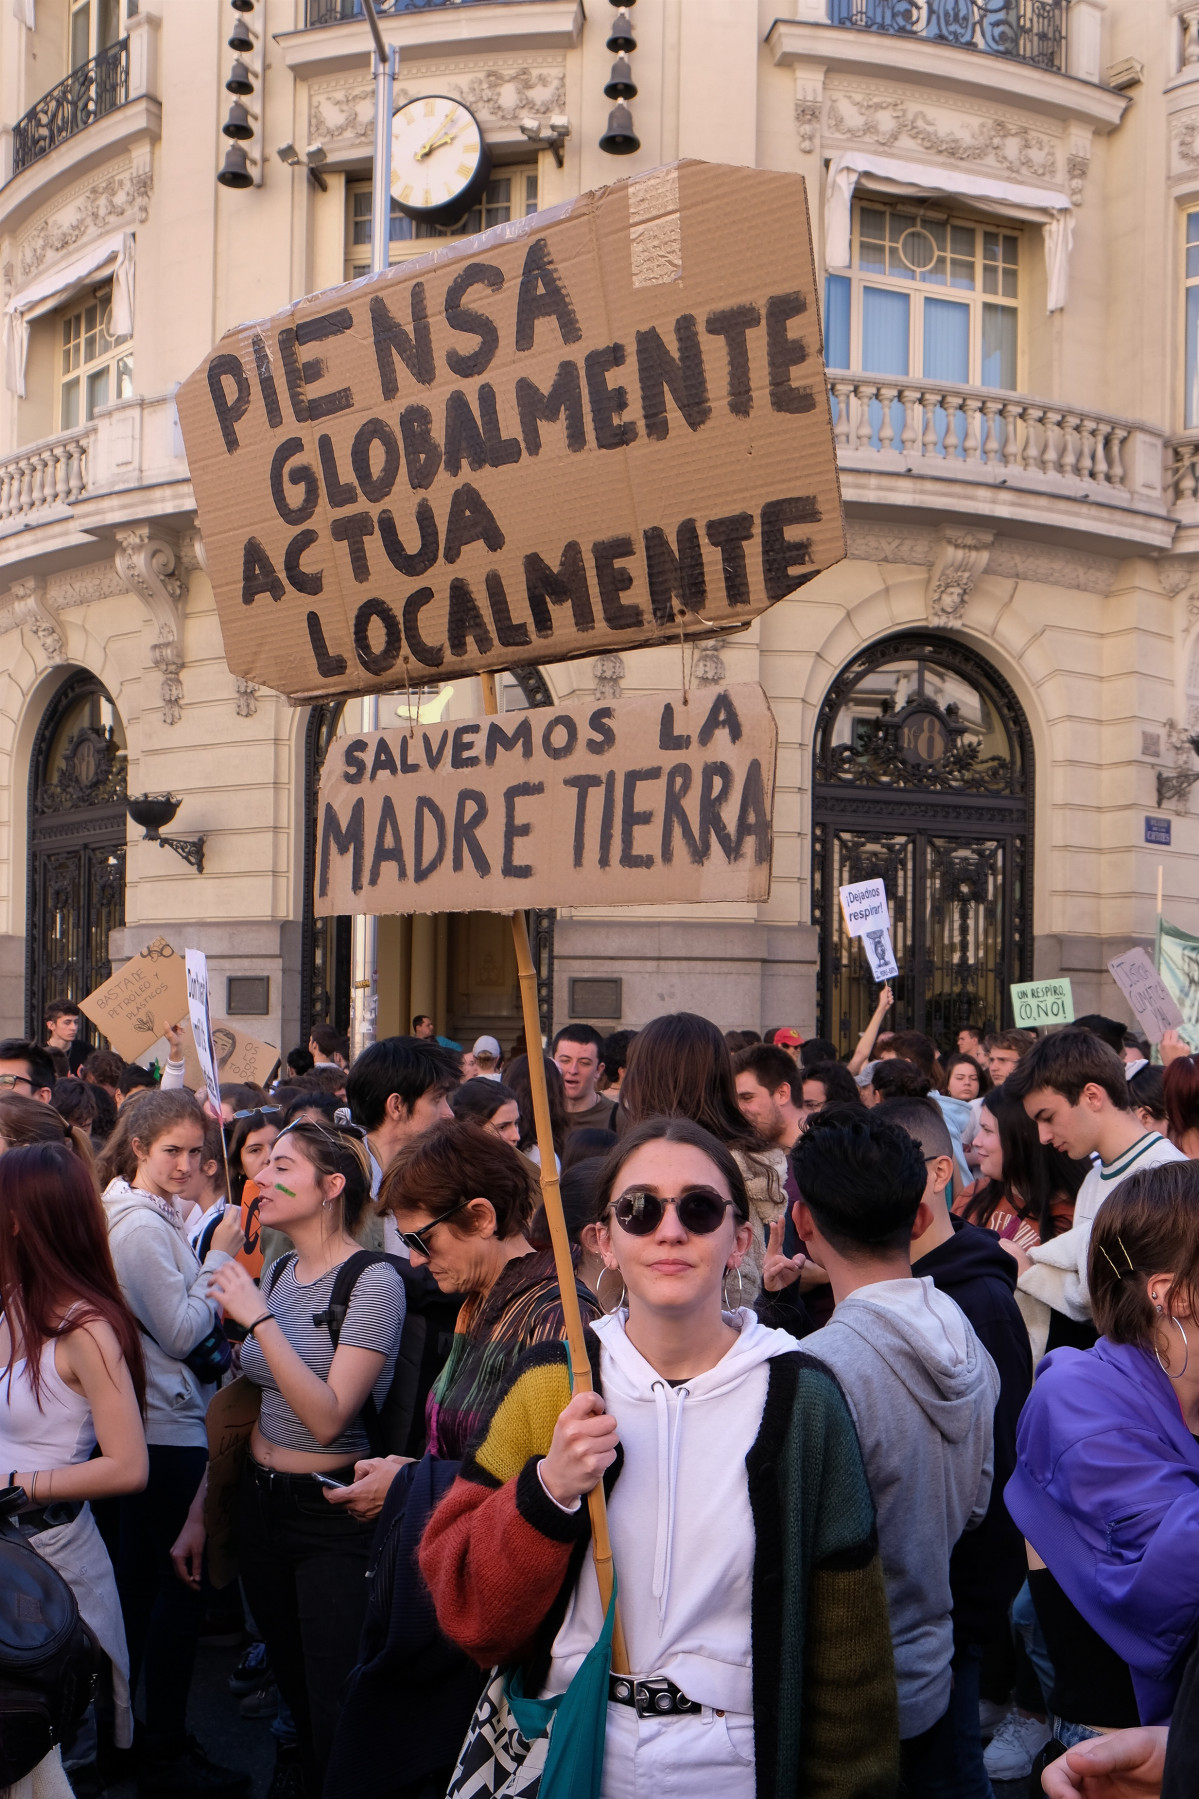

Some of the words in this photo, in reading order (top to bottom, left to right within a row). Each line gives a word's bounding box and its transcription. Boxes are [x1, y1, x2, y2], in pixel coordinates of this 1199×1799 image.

[207, 238, 582, 454] PIENSA
[269, 290, 817, 526] GLOBALMENTE
[241, 482, 505, 606] ACTUA
[307, 495, 823, 678] LOCALMENTE
[343, 706, 617, 785] SALVEMOS
[658, 690, 743, 751] LA
[917, 716, 945, 761] 8
[319, 781, 545, 899] MADRE
[563, 758, 770, 870] TIERRA
[96, 976, 134, 1010] BASTA
[131, 968, 147, 983] DE
[153, 971, 160, 980] Y
[1017, 989, 1029, 1000] UN
